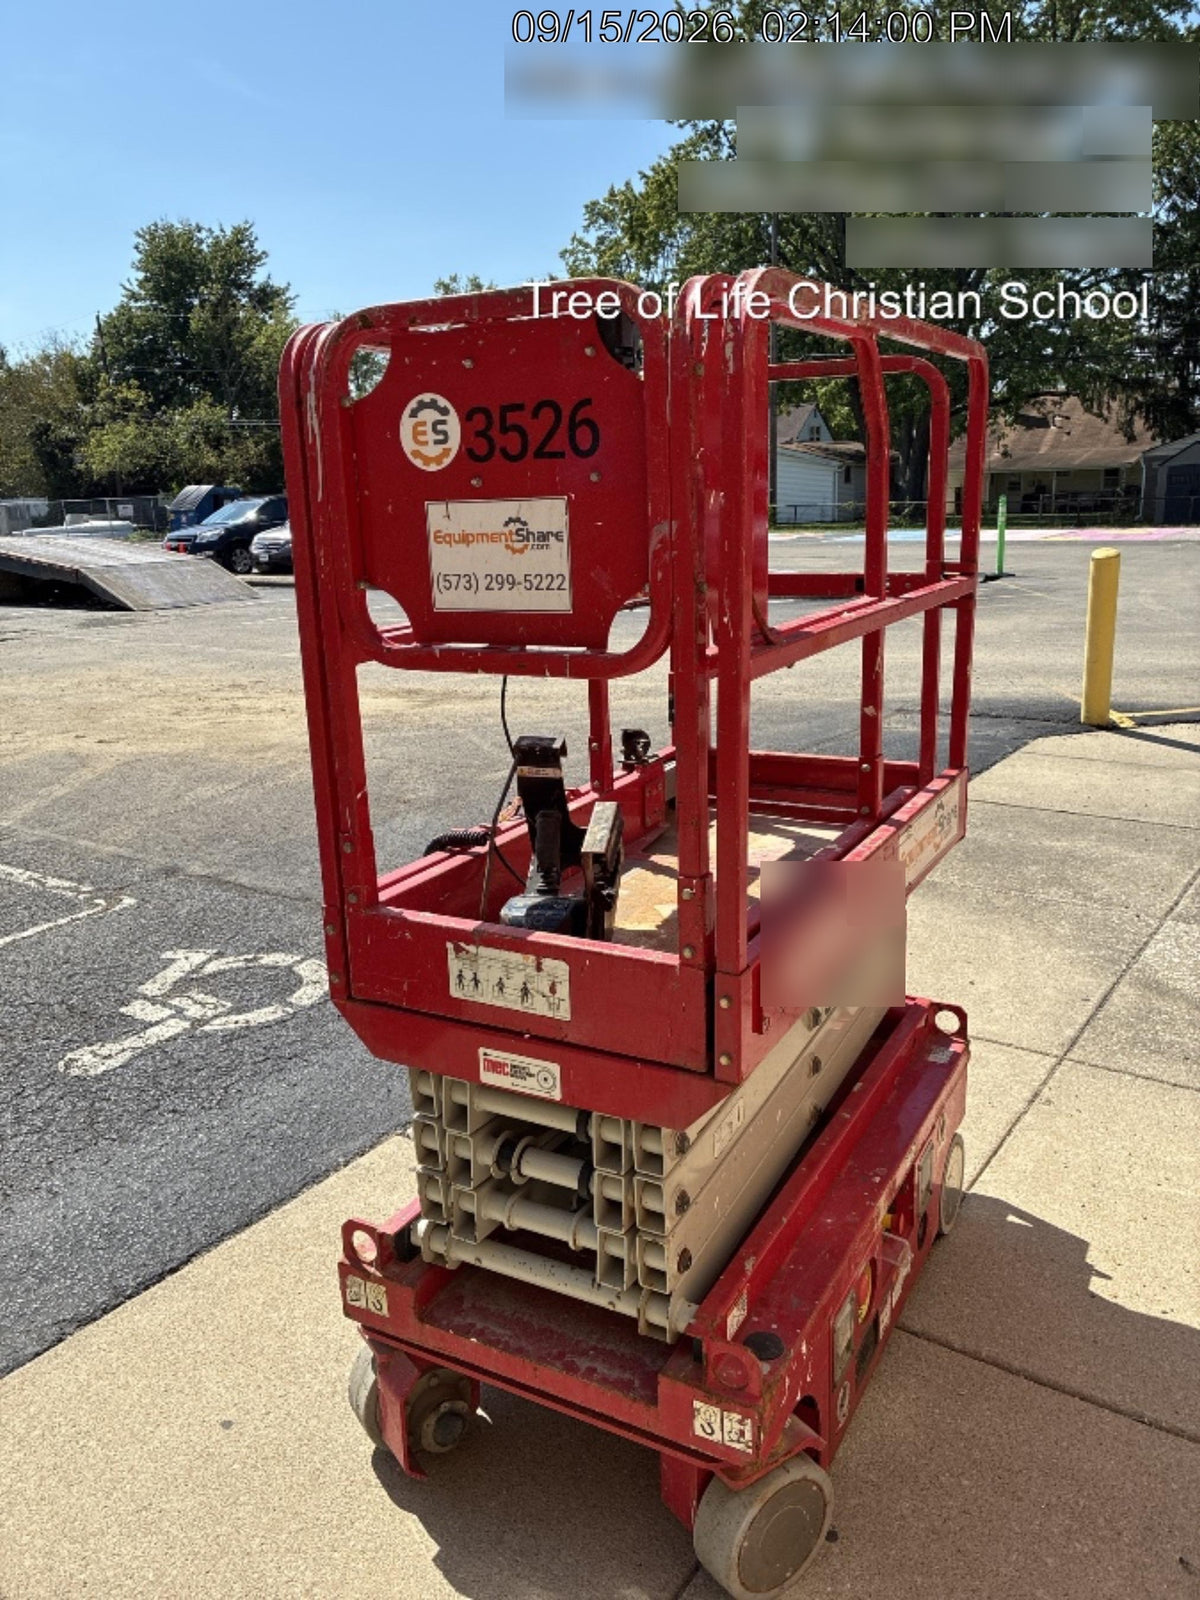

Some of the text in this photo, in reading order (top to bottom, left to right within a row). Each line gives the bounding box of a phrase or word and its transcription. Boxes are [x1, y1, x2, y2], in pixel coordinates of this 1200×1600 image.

[411, 398, 600, 463] ES 3526
[433, 527, 565, 548] EquipmentShare
[436, 571, 567, 595] (573) 299-5222
